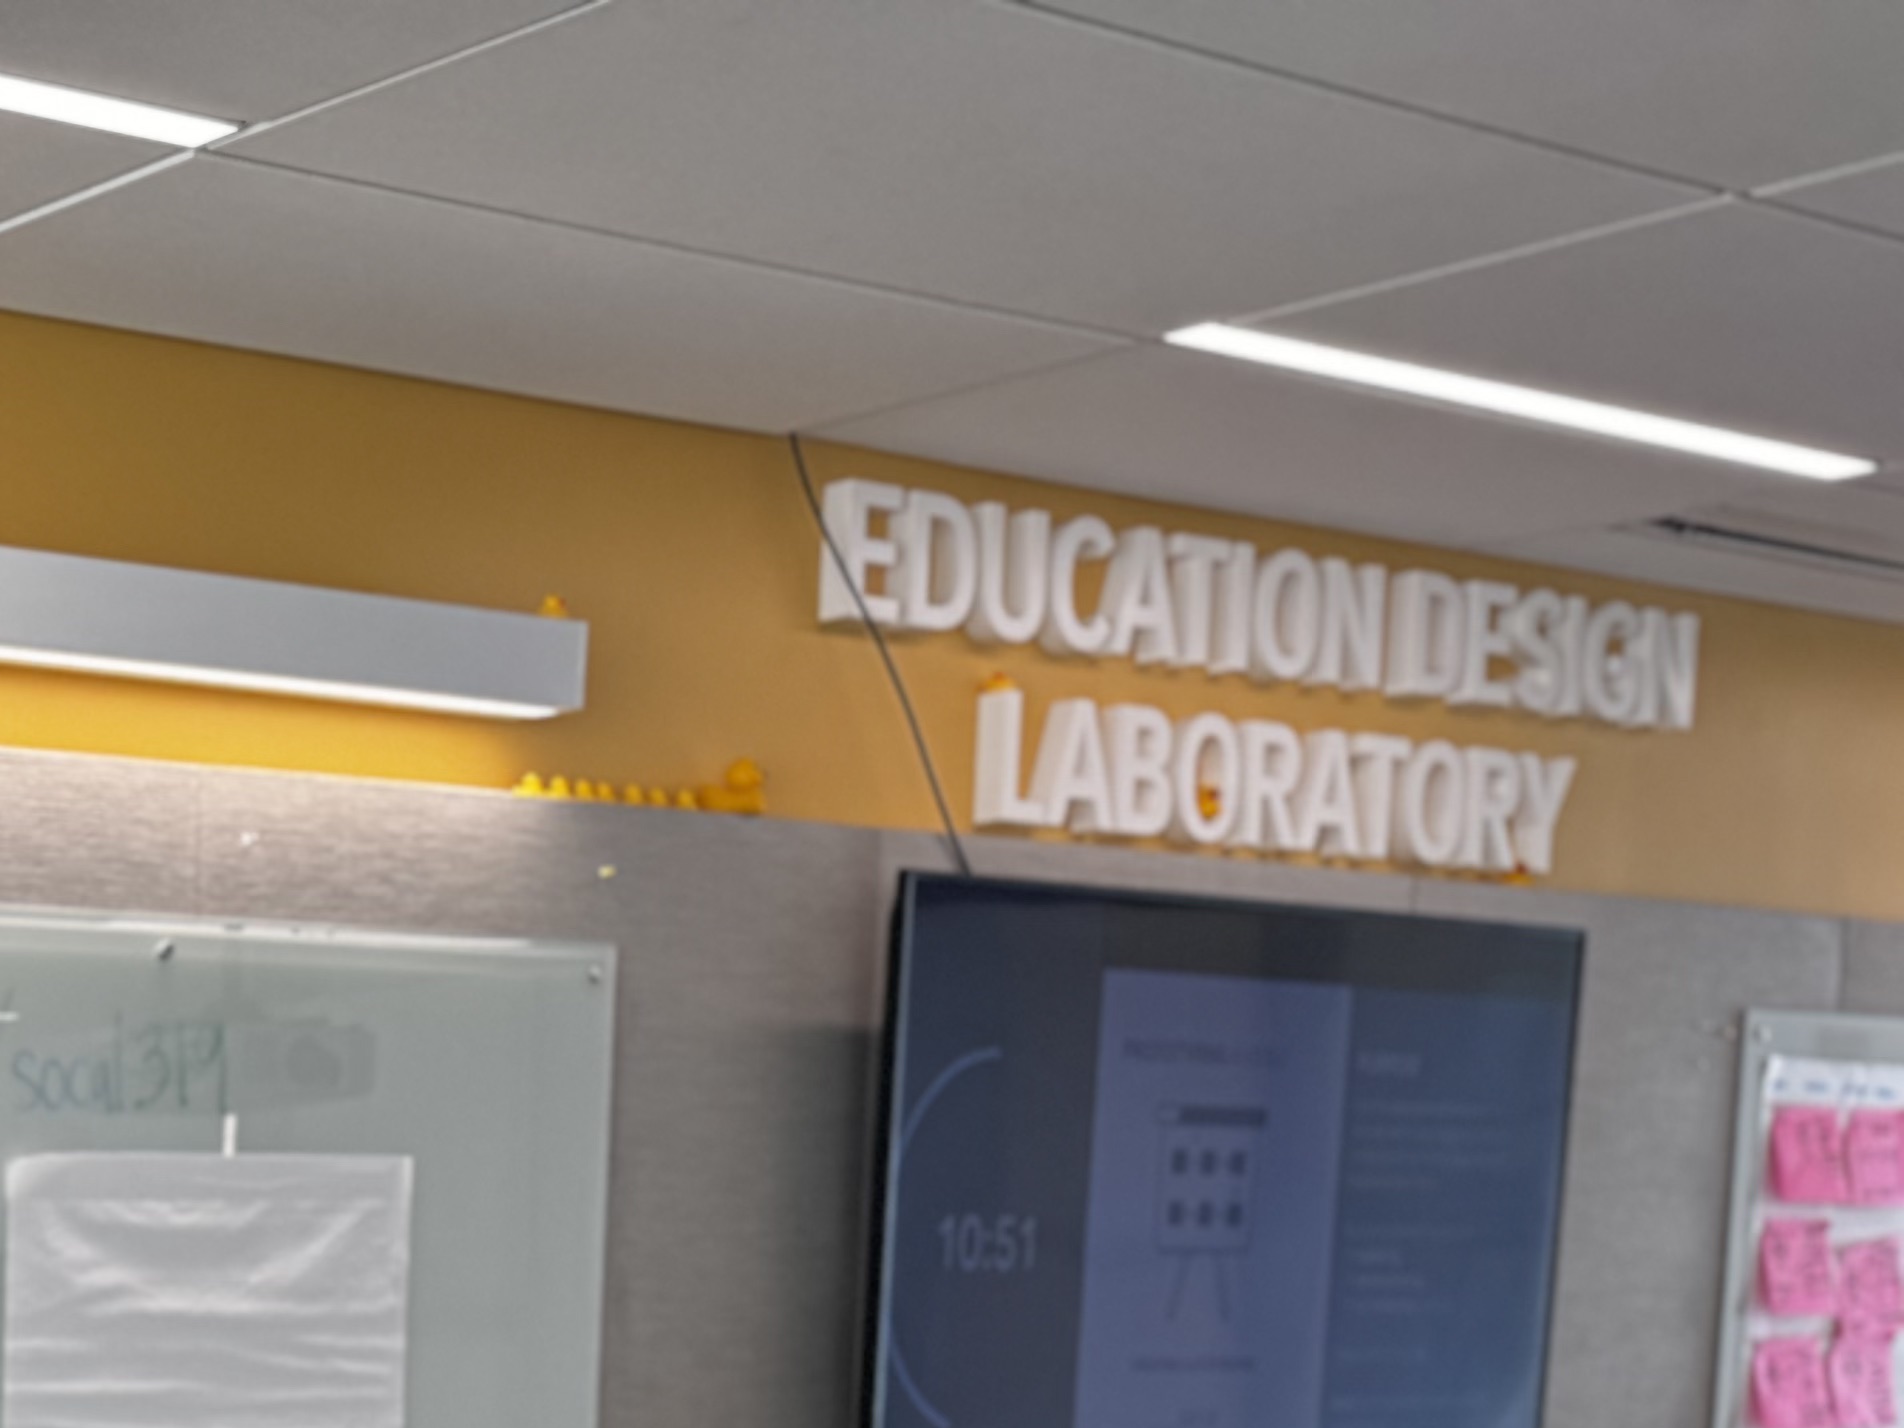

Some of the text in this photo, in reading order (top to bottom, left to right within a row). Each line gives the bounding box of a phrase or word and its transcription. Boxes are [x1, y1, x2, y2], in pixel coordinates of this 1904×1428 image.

[818, 477, 1699, 729] EDUCATION DESIGN
[973, 689, 1574, 874] LABORATORY
[937, 1214, 1038, 1272] 10:51
